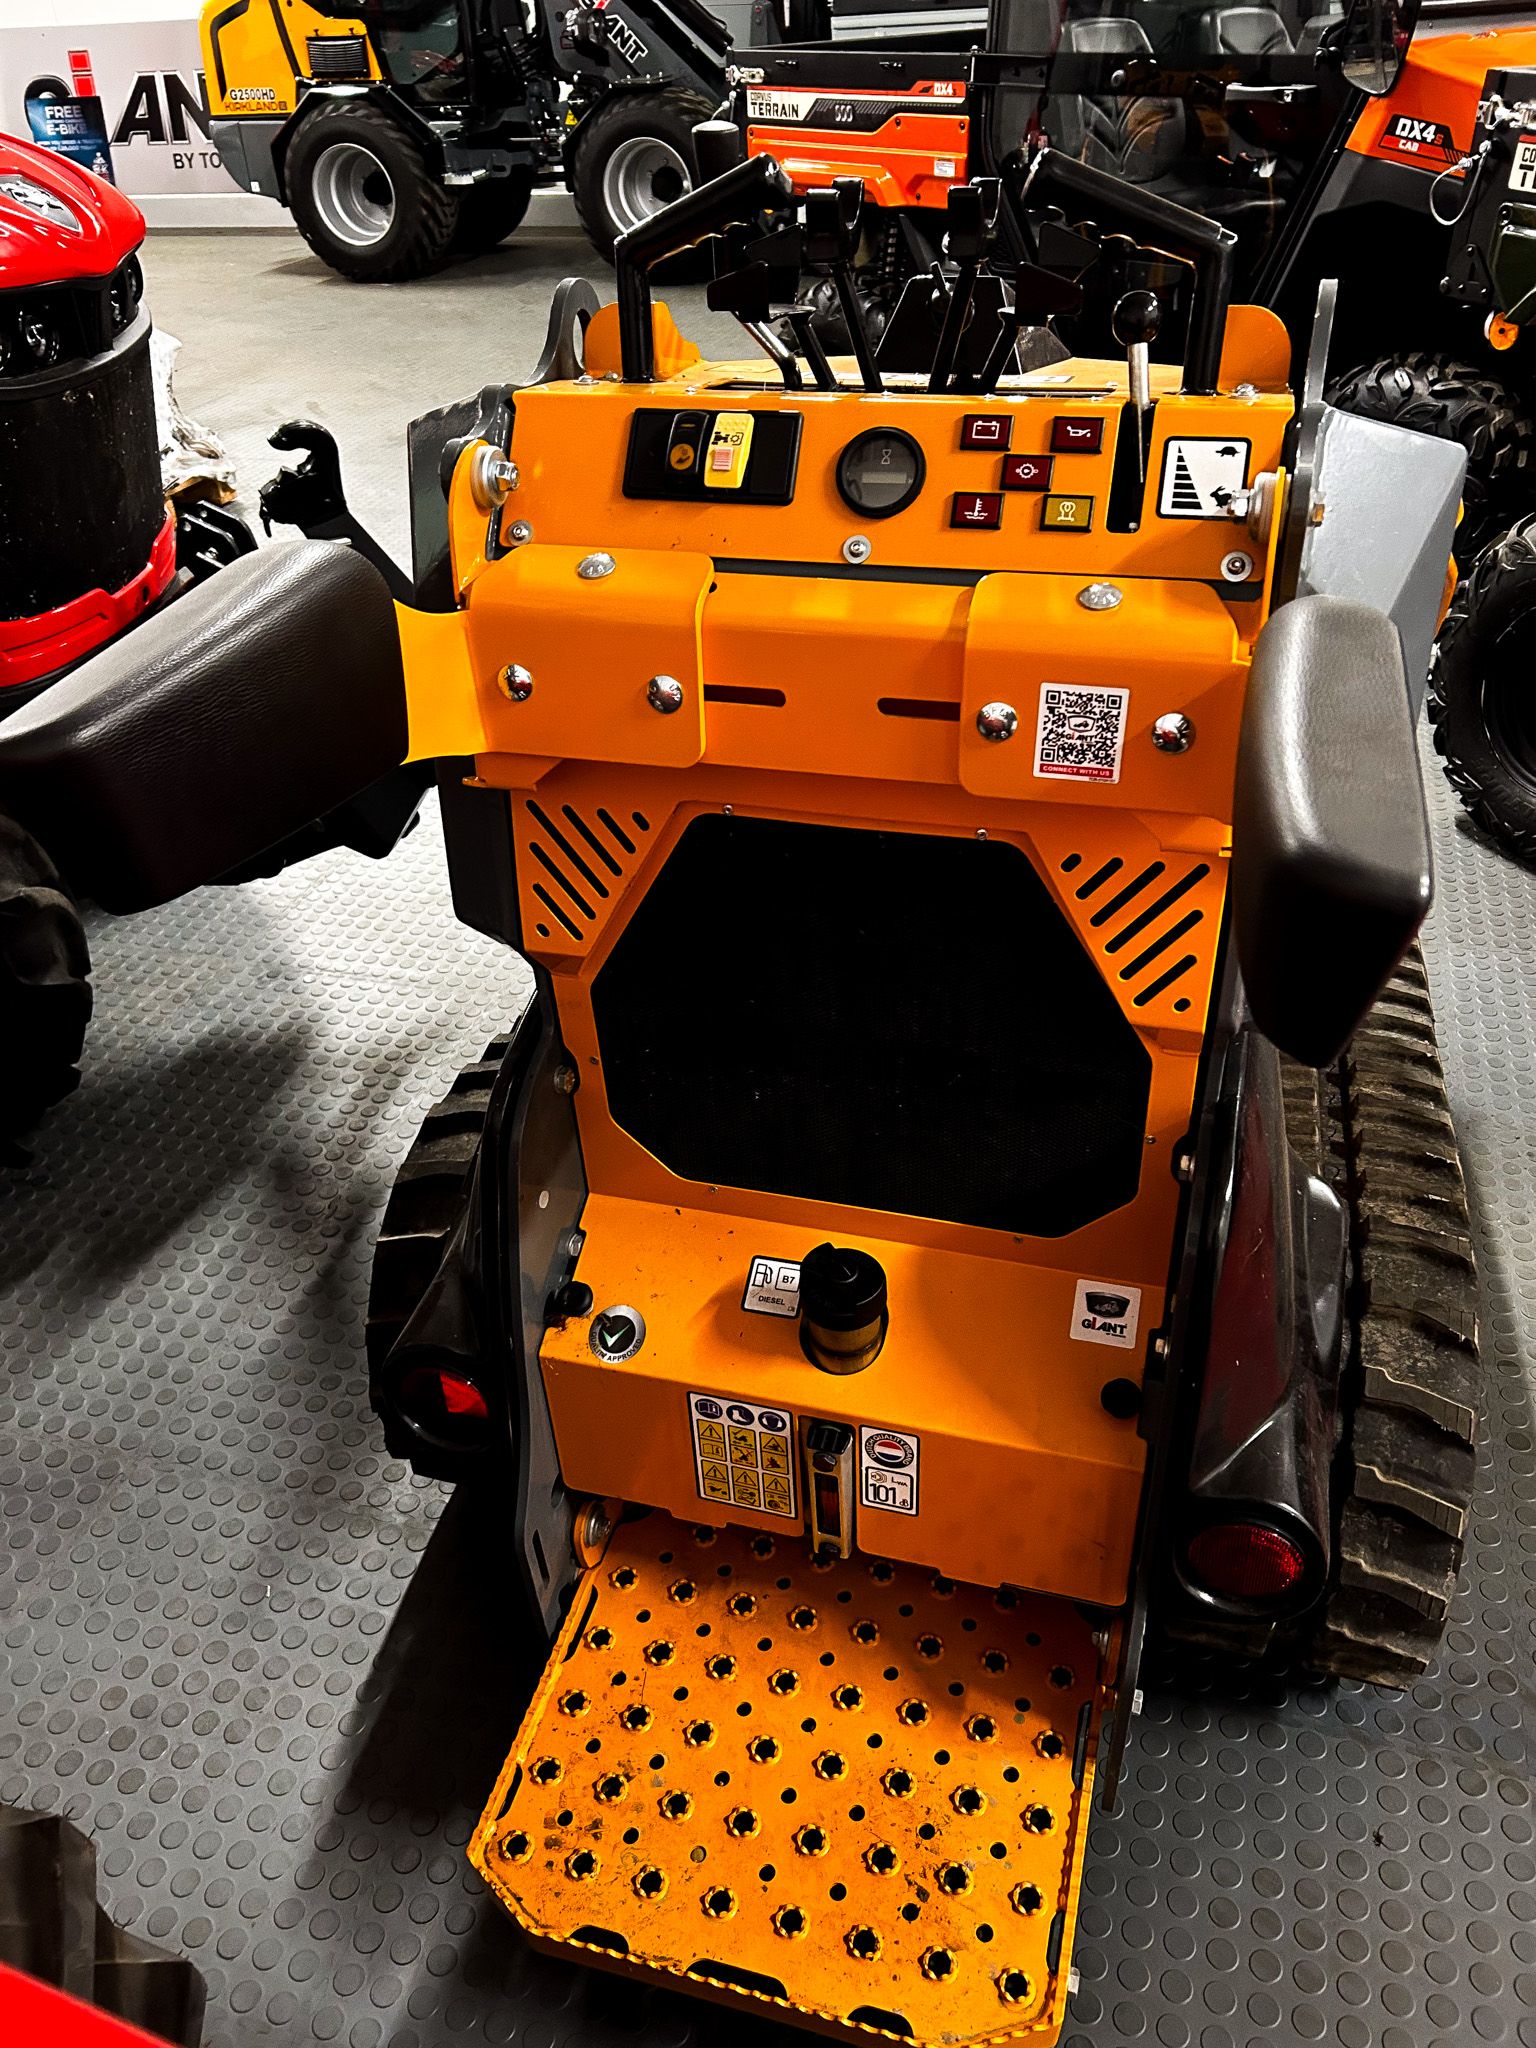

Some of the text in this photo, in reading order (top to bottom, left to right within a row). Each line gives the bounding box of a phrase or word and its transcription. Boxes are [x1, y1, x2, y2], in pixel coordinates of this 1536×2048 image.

[229, 88, 276, 101] G2500HD
[45, 105, 83, 119] FREE
[750, 102, 800, 119] TERRAIN
[46, 123, 87, 136] E-BIKE
[1399, 139, 1419, 152] CAB
[172, 153, 194, 169] BY
[1518, 163, 1536, 189] T
[1043, 765, 1077, 774] CONNECT
[782, 1275, 796, 1285] B7
[758, 1295, 786, 1306] DIESEL
[606, 1338, 642, 1361] APPROVED
[866, 1433, 914, 1466] DUTCH QUALITY BRAND
[869, 1483, 897, 1505] 101
